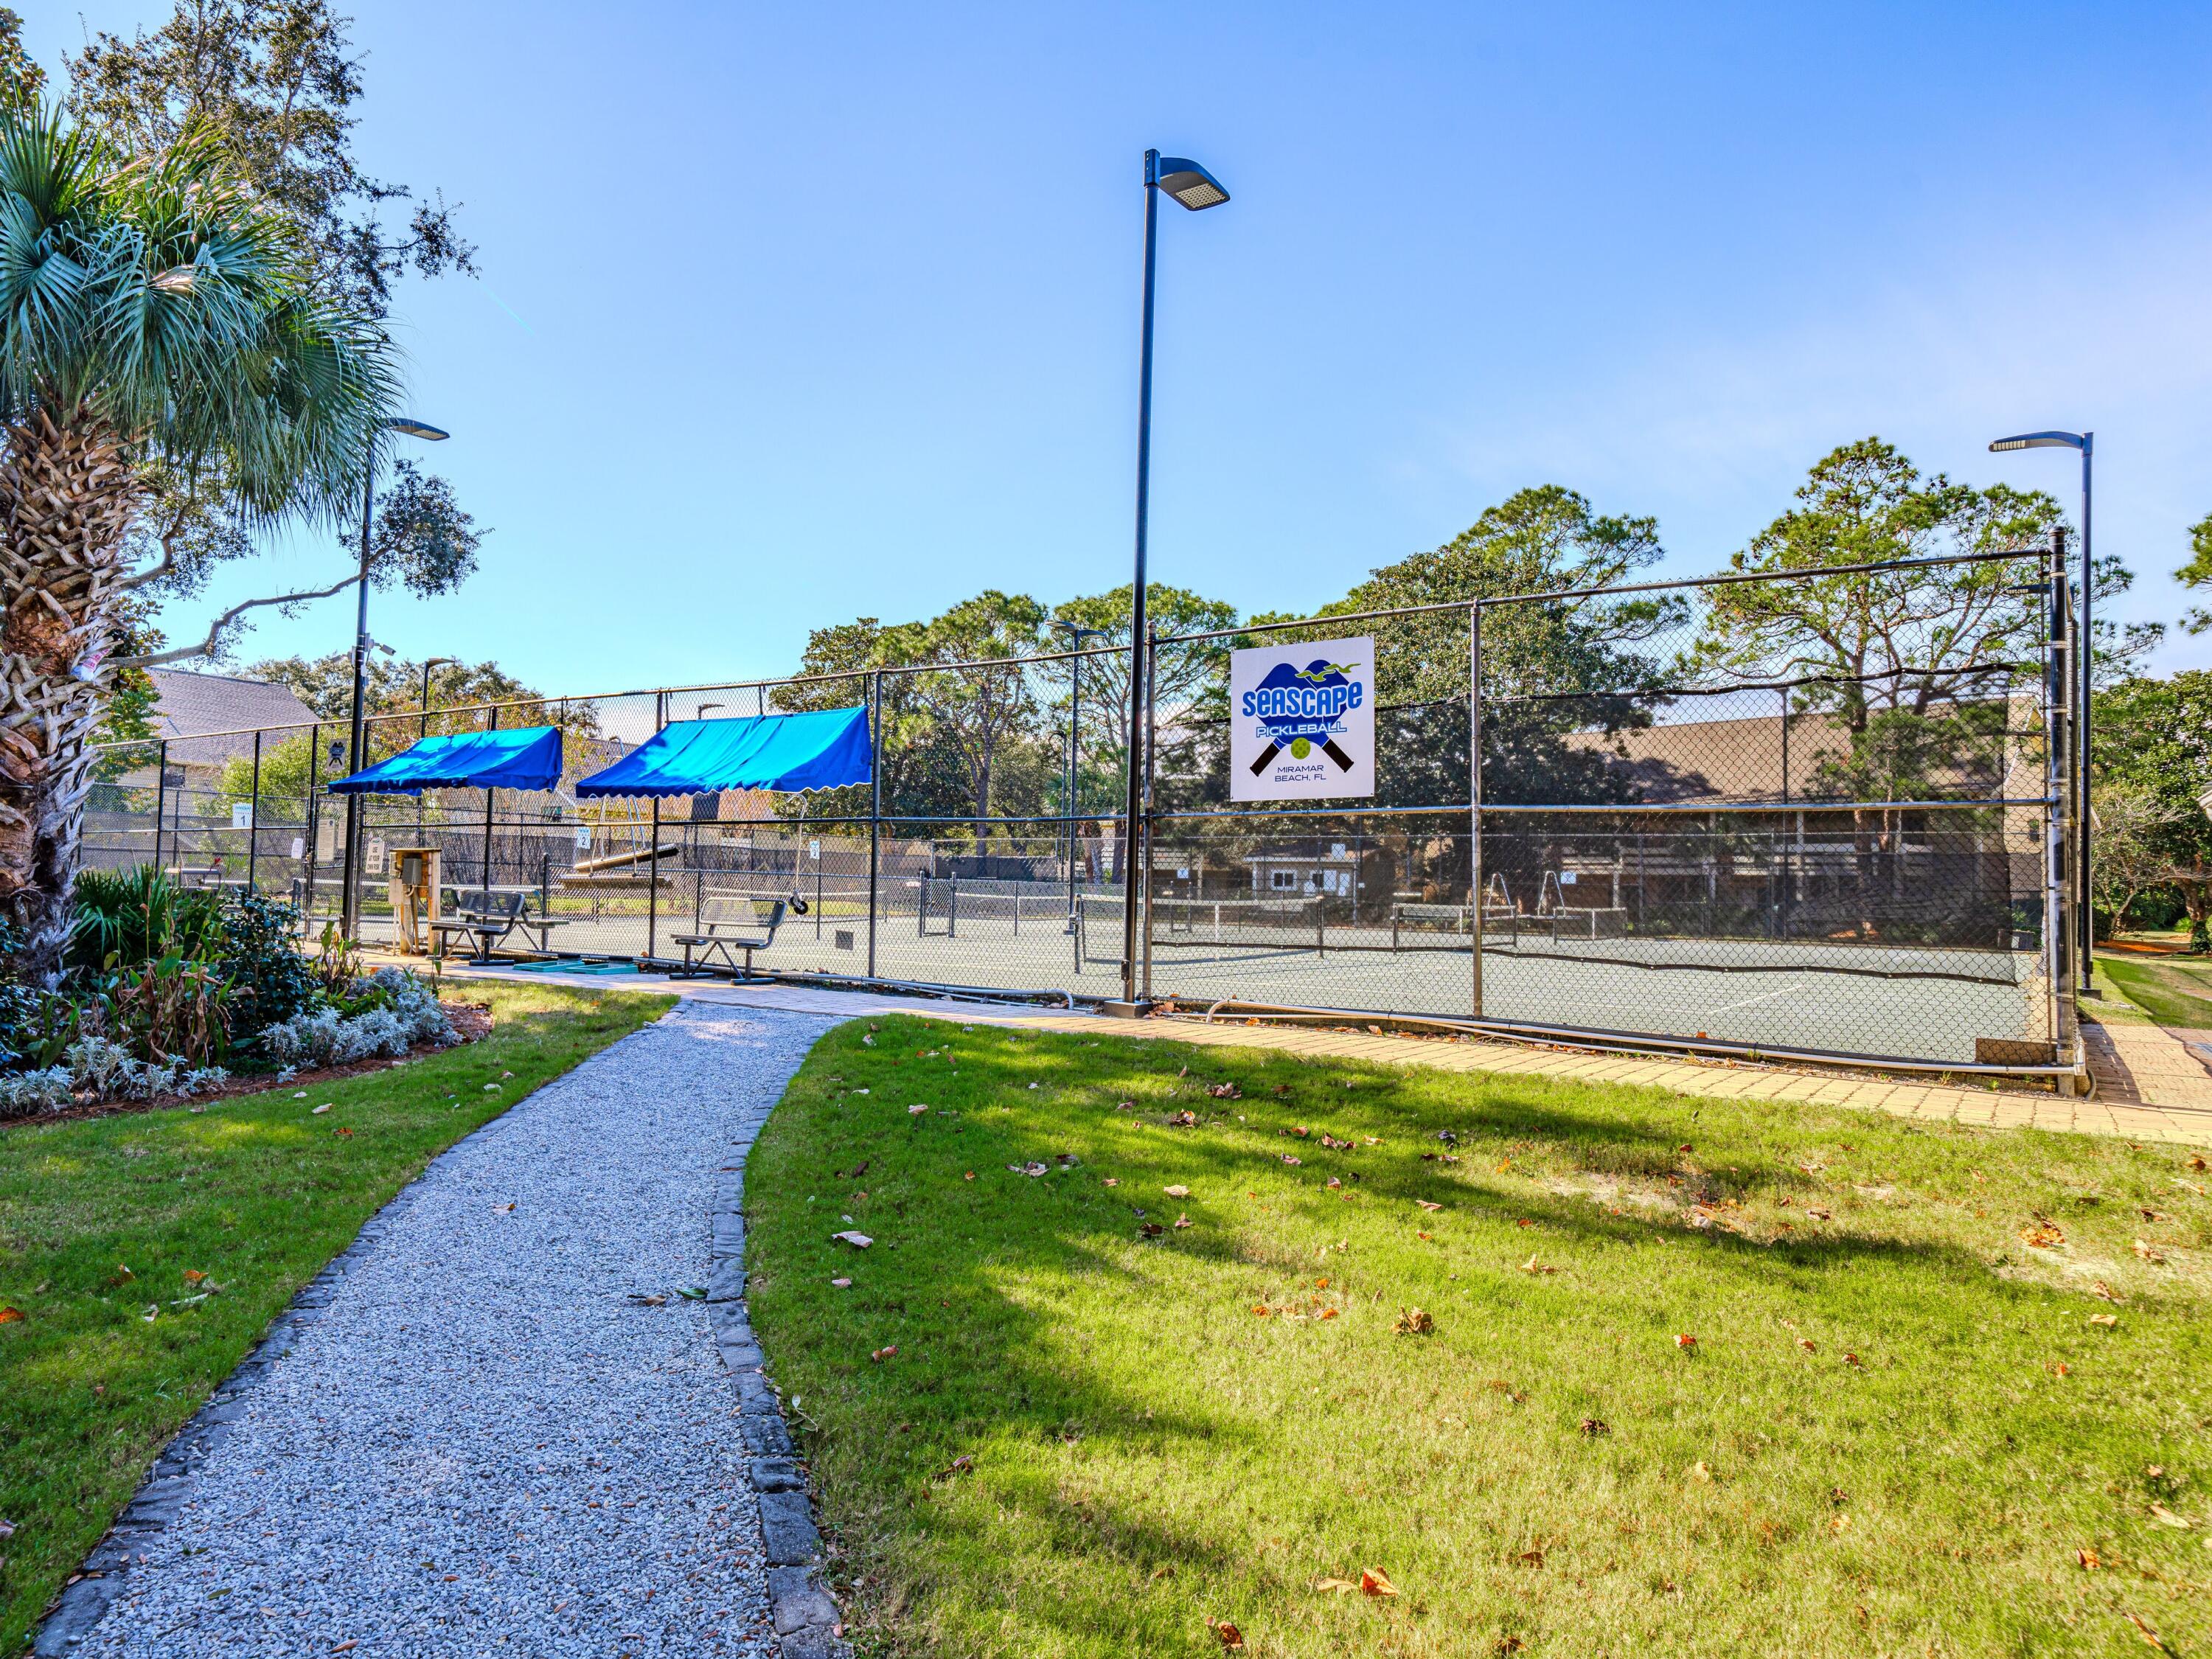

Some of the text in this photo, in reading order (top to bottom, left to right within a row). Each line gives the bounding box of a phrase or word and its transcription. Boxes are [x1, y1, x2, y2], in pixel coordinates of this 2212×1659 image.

[1256, 721, 1347, 737] PICKLEBALL
[1277, 765, 1324, 773] MIRAMAR
[1275, 774, 1311, 782] BEACH,
[241, 815, 246, 826] 1
[582, 837, 586, 845] 2
